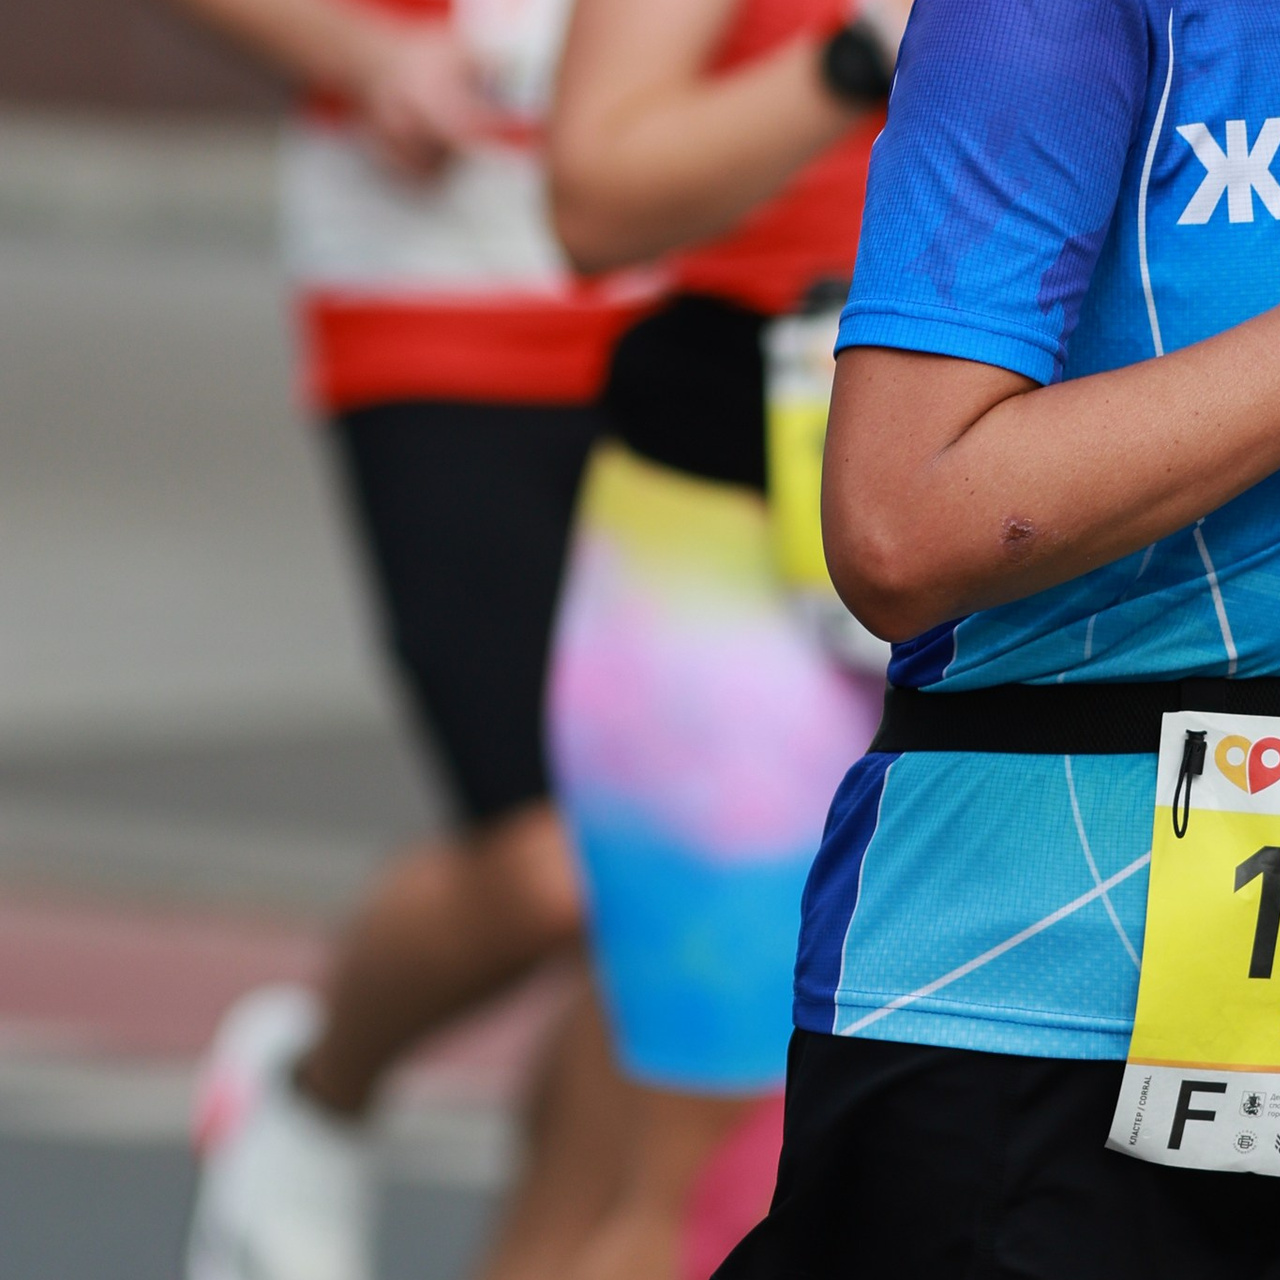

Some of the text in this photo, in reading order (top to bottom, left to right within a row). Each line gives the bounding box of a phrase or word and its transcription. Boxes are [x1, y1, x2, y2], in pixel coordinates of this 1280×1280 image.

[1129, 1111, 1145, 1146] КЛАСТЕР
[1138, 1075, 1152, 1106] CORRAL
[1167, 1080, 1228, 1150] F
